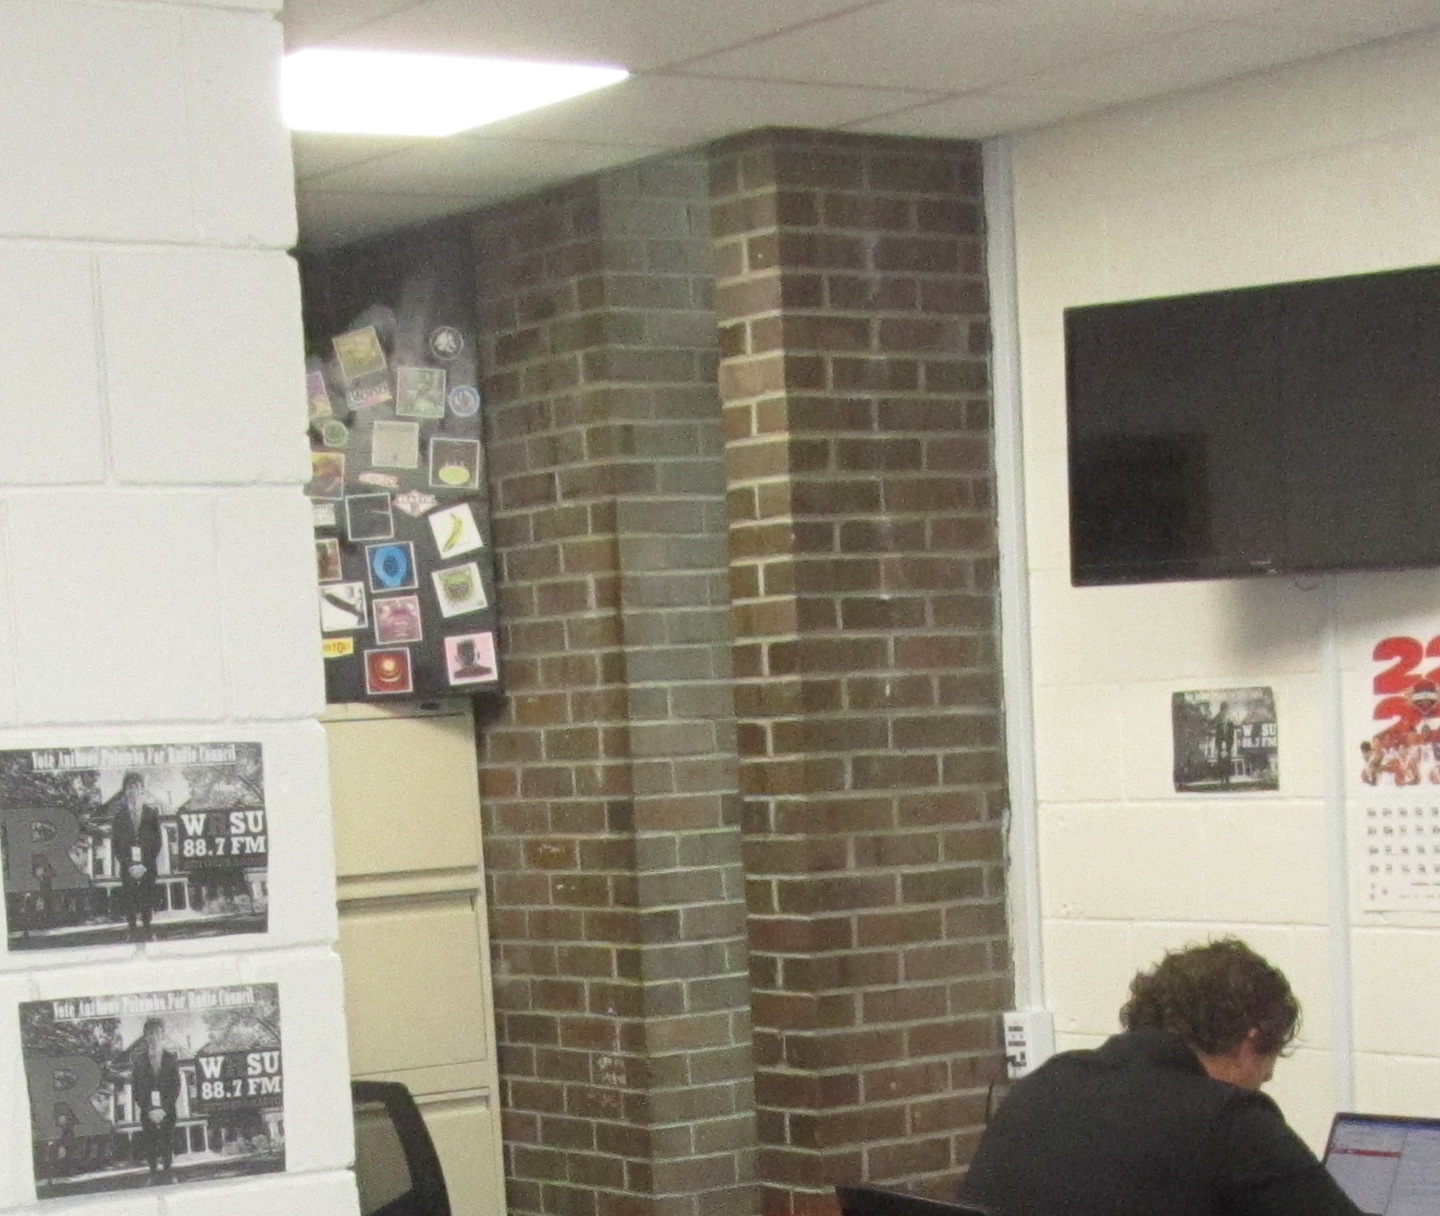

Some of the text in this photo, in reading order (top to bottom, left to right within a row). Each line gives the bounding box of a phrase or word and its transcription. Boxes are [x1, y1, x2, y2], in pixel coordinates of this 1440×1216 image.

[1242, 723, 1277, 737] WSU
[180, 810, 264, 836] WSU
[183, 835, 267, 857] 88.7 FM
[200, 1050, 282, 1080] WSU
[202, 1076, 283, 1100] 88.7 FM
